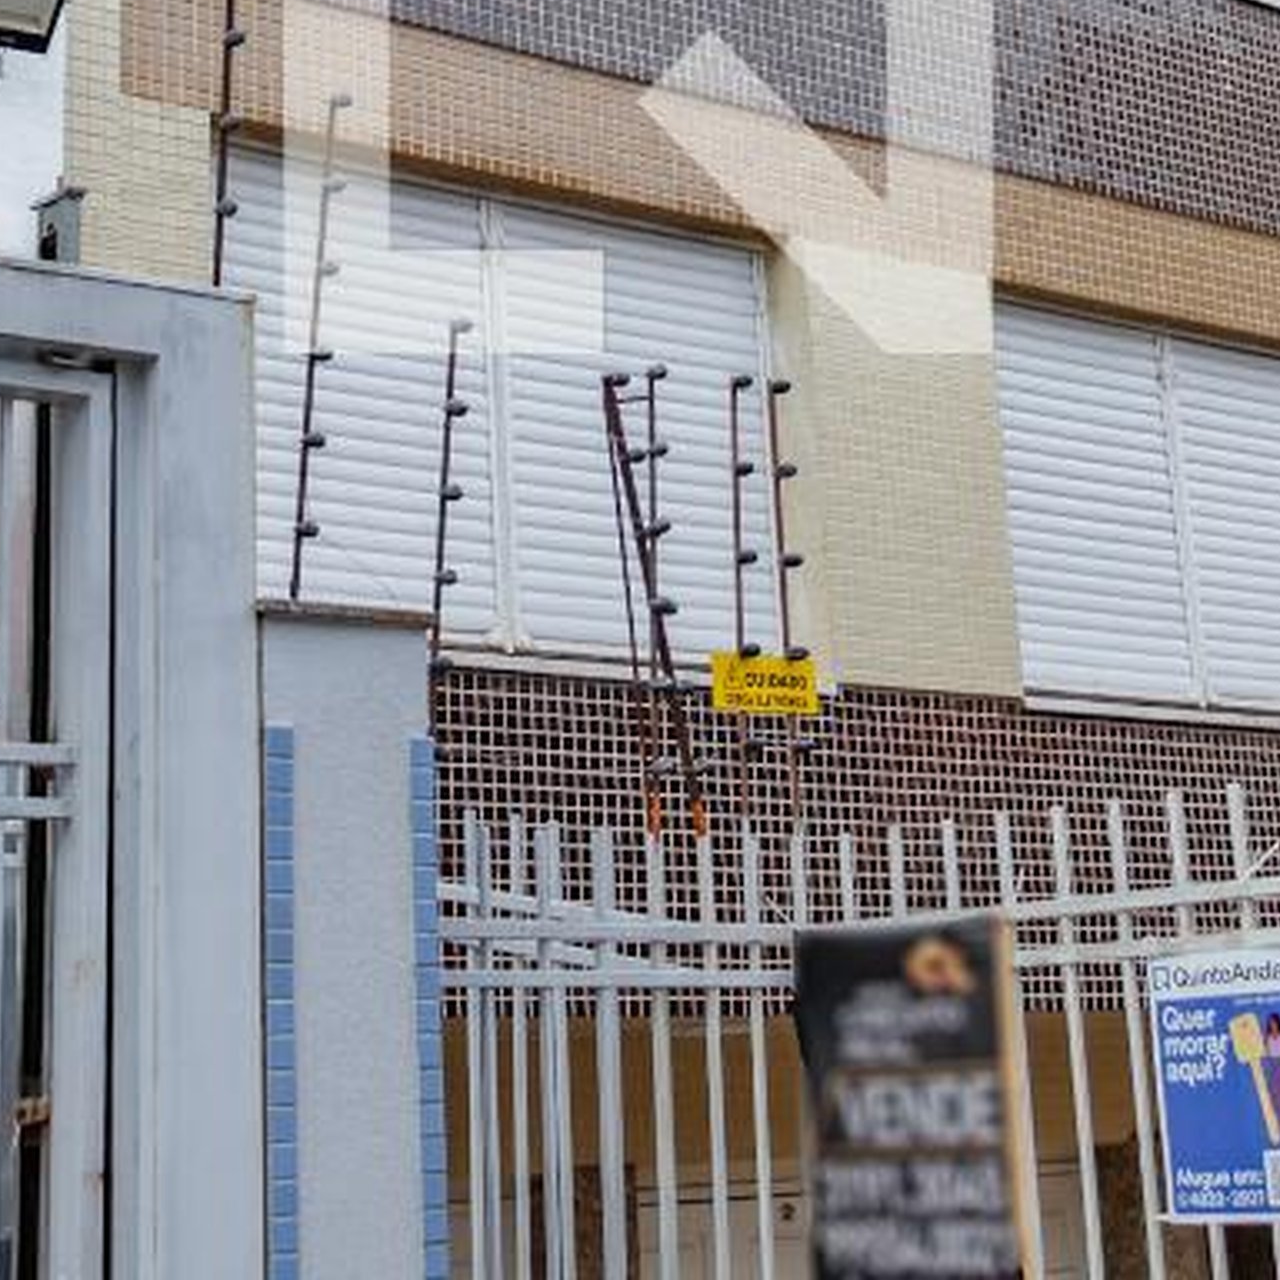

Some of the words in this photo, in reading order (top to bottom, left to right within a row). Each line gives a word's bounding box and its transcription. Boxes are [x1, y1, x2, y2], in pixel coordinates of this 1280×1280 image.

[1161, 1005, 1216, 1033] Quer
[1163, 1034, 1228, 1058] morar
[1166, 1054, 1226, 1088] aqui?
[838, 1072, 1001, 1146] VENDE
